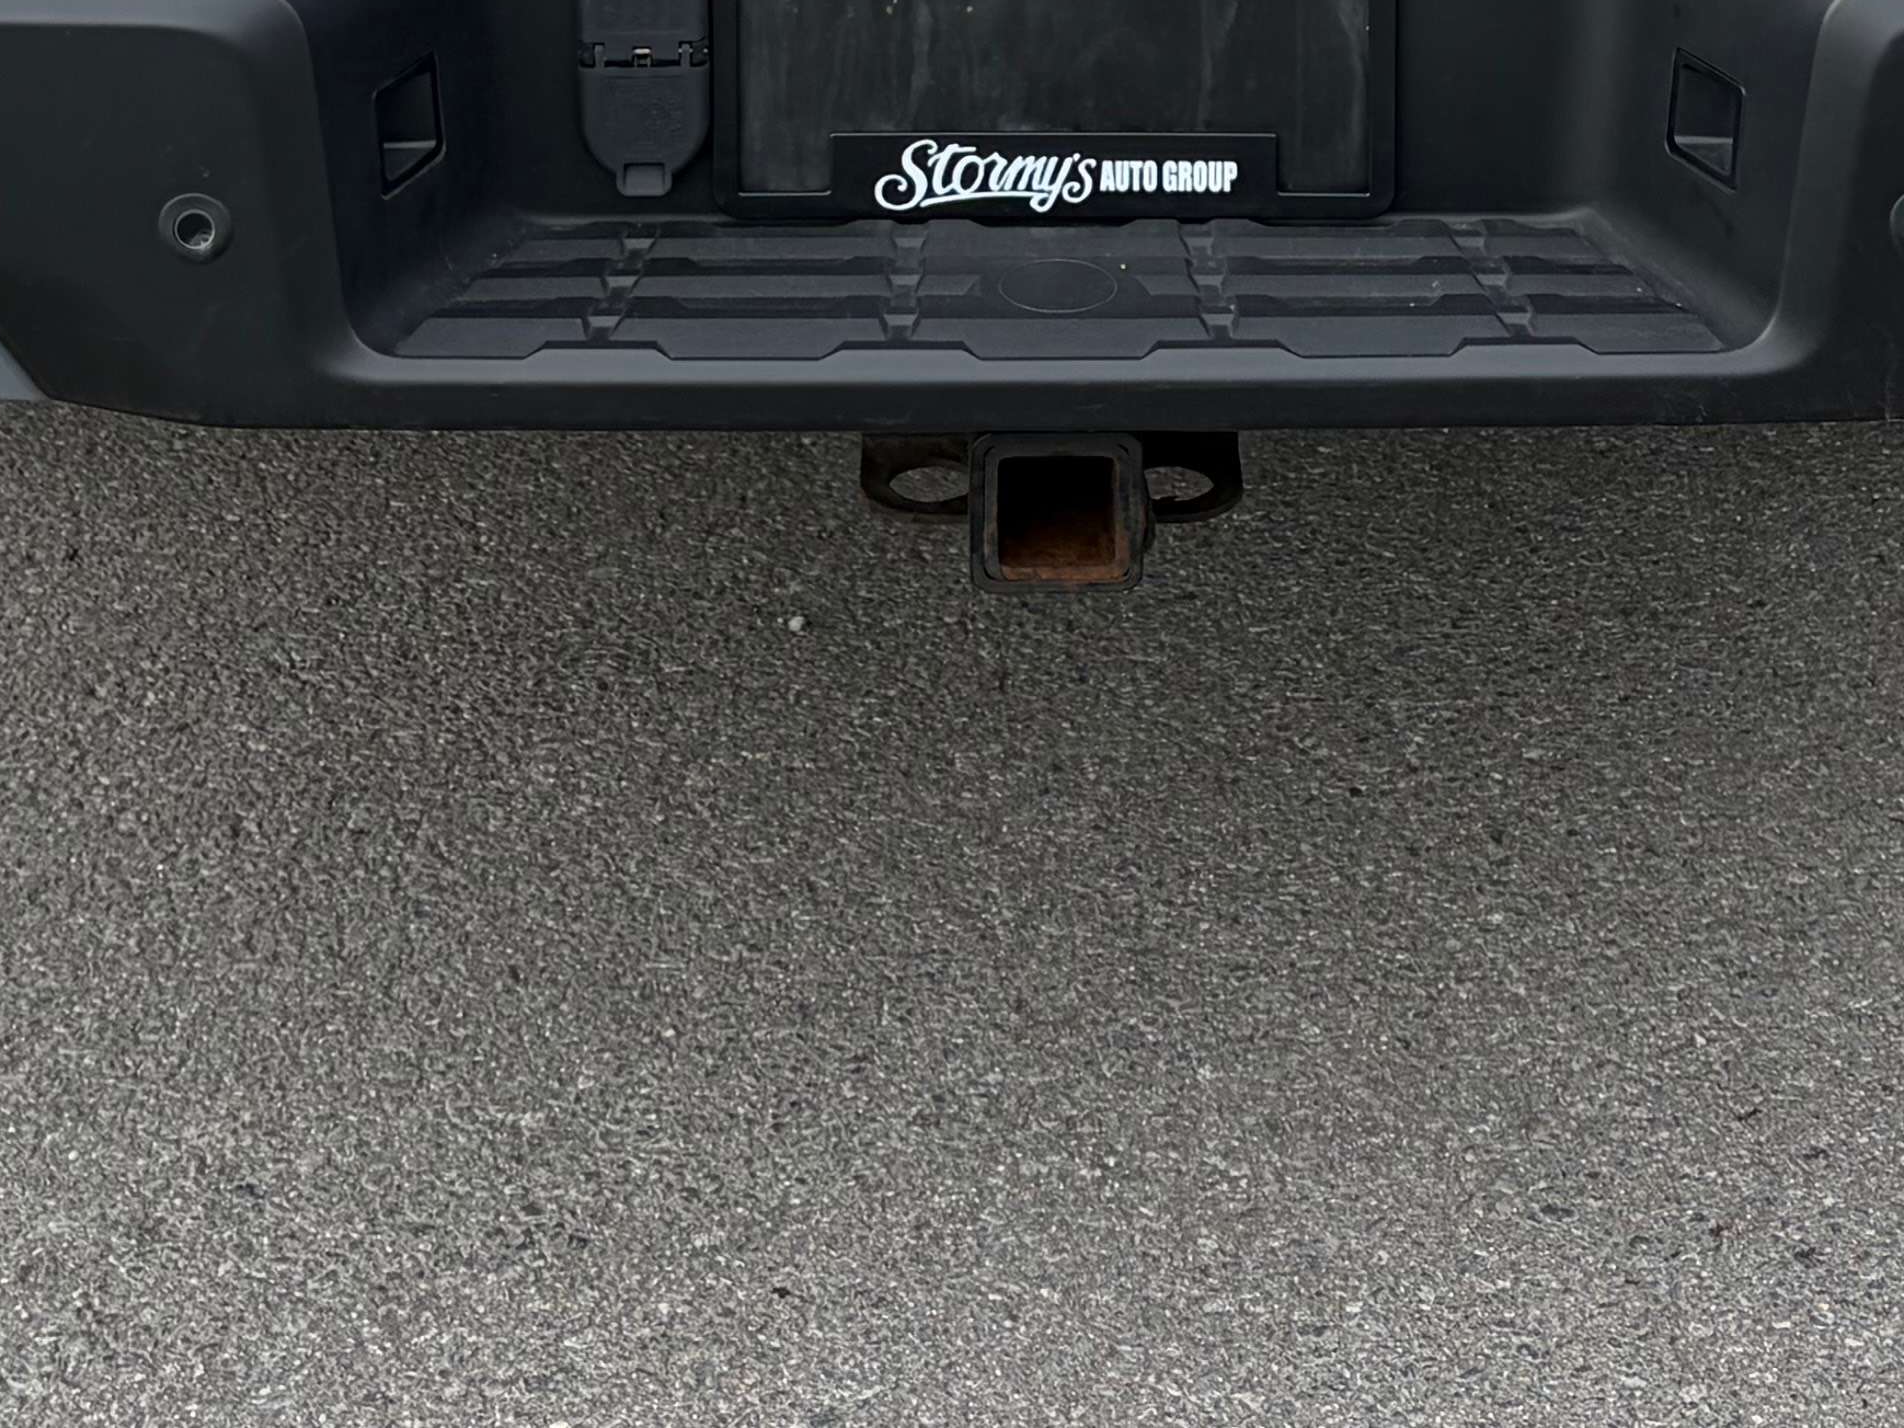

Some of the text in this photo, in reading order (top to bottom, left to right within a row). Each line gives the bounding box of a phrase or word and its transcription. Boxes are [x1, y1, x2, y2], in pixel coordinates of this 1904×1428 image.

[874, 139, 1238, 213] Stormy's AUTO GROUP
